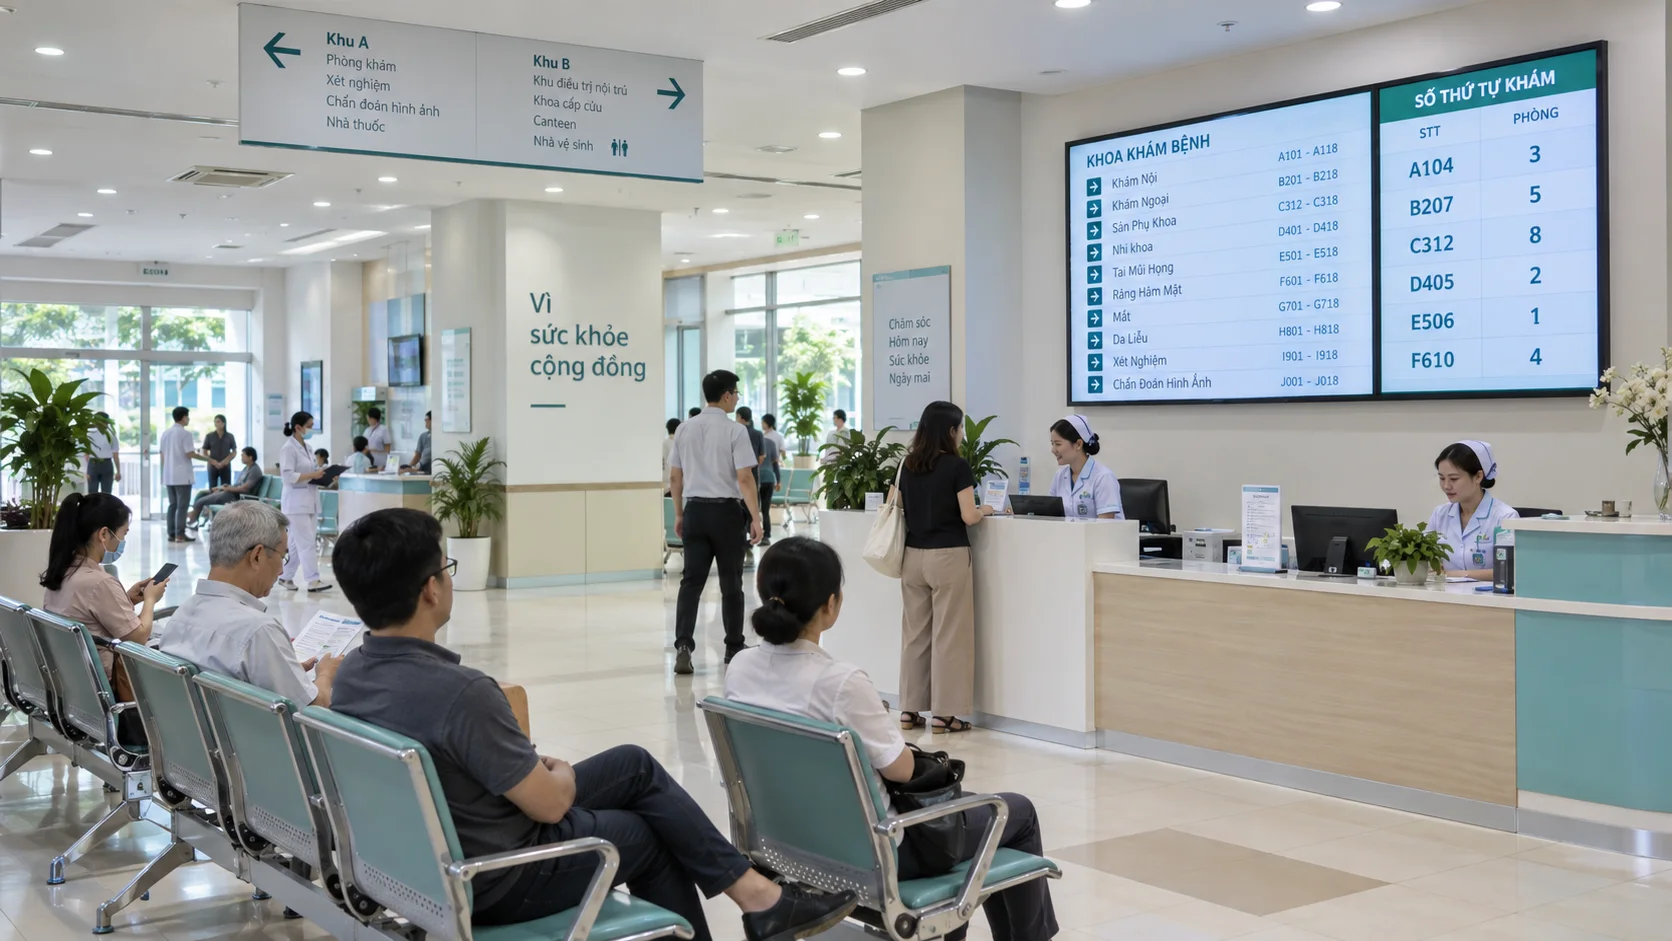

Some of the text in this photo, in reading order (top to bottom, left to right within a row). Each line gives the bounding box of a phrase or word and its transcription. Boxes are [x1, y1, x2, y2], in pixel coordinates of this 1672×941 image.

[326, 31, 369, 49] Khu A
[326, 53, 397, 72] Phòng khám
[533, 54, 570, 69] Khu B
[349, 77, 391, 92] nghiệm
[533, 75, 553, 87] Khu
[613, 84, 627, 95] trú
[1414, 68, 1555, 108] SỐ THỨ TỰ KHÁM
[391, 101, 416, 115] hình
[533, 95, 560, 108] Khoa
[533, 115, 577, 129] Canteen
[1513, 106, 1559, 124] PHÒNG
[326, 116, 385, 132] Nhà thuốc
[1419, 125, 1441, 138] STT
[572, 139, 594, 151] sinh
[1086, 133, 1210, 168] KHOA KHÁM BỆNH
[1278, 149, 1301, 162] A101
[1313, 143, 1338, 156] A118
[1529, 145, 1541, 163] 3
[1409, 157, 1454, 178] A104
[1112, 172, 1157, 189] Khám Nội
[1278, 174, 1301, 187] B201
[1313, 169, 1338, 181] B218
[1112, 193, 1169, 211] Khám Ngoại
[1529, 185, 1541, 203] 5
[1278, 200, 1302, 212] C312
[1313, 195, 1338, 207] C318
[1410, 196, 1454, 216] B207
[1131, 218, 1150, 231] Phụ
[1152, 216, 1177, 228] Khoa
[1278, 225, 1301, 237] D401
[1313, 221, 1338, 233] D418
[1529, 225, 1541, 243] 8
[1112, 240, 1153, 255] Nhi khoa
[1410, 234, 1454, 253] C312
[1279, 250, 1302, 262] E501
[1314, 247, 1338, 258] E518
[1113, 267, 1126, 278] Tai
[1148, 262, 1174, 275] Họng
[1529, 266, 1541, 284] 2
[1279, 275, 1302, 286] F601
[1314, 272, 1338, 283] F618
[1410, 273, 1454, 292] D405
[529, 292, 550, 313] Vì
[1278, 300, 1302, 312] G701
[1314, 298, 1339, 309] G718
[1411, 312, 1454, 330] E506
[1530, 307, 1540, 325] 1
[530, 323, 628, 346] sức khỏe
[1278, 326, 1302, 337] H801
[1314, 324, 1339, 335] H818
[912, 336, 928, 348] nay
[1112, 334, 1125, 345] Da
[1112, 355, 1167, 369] Xét Nghiệm
[1282, 350, 1303, 361] I901
[1316, 350, 1338, 360] I918
[1411, 351, 1454, 368] F610
[1529, 348, 1542, 365] 4
[530, 354, 645, 382] cộng đồng
[914, 371, 930, 383] mai
[1139, 377, 1164, 390] Đoán
[1166, 377, 1189, 389] Hình
[1280, 376, 1303, 387] J001
[1314, 375, 1339, 386] J018
